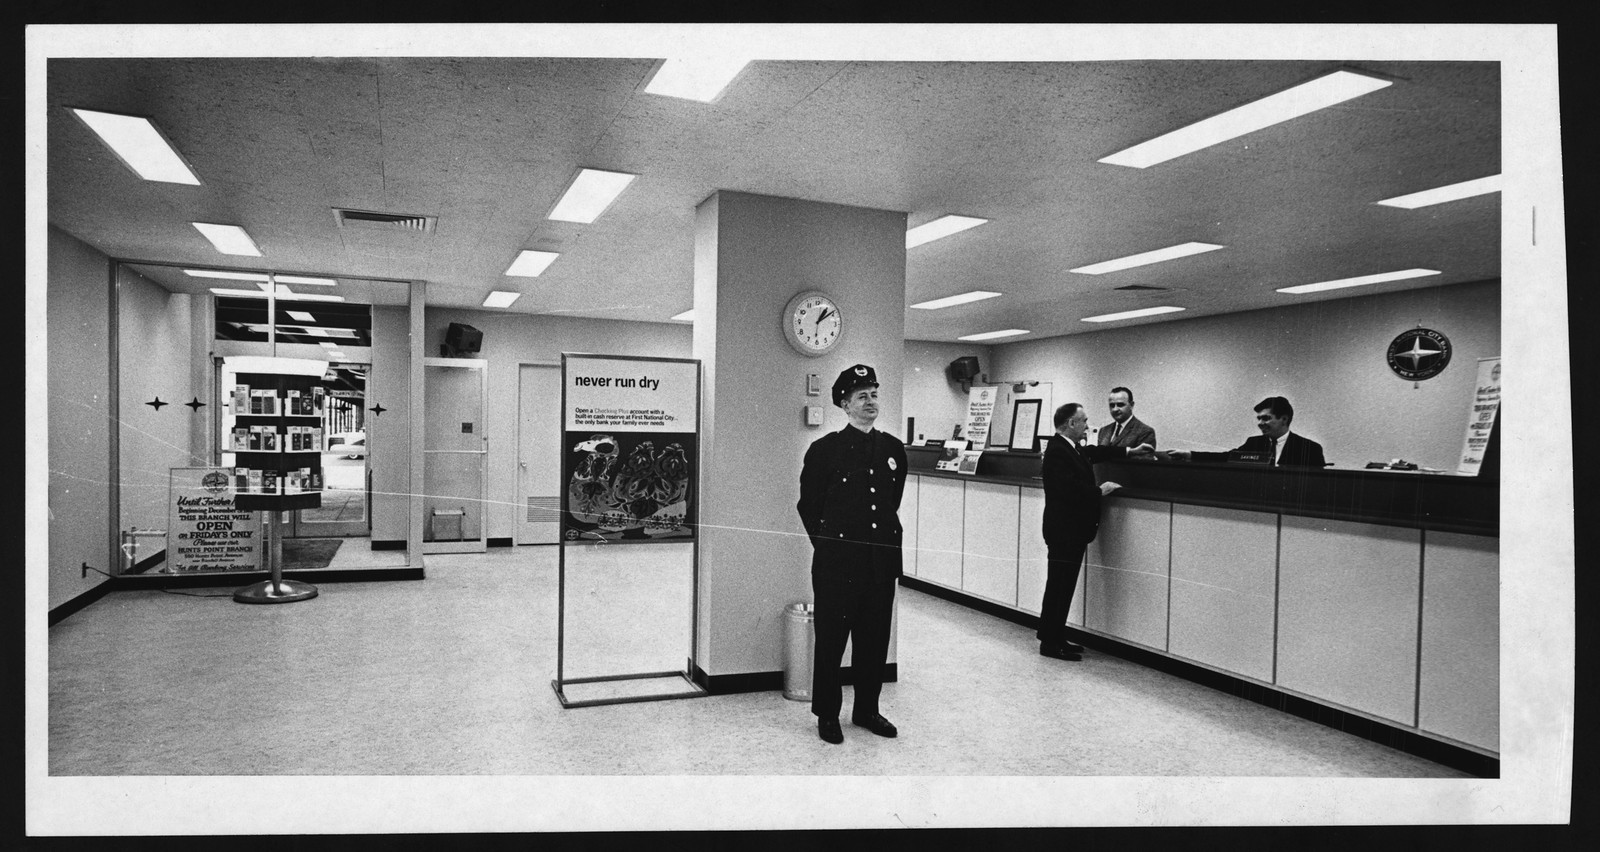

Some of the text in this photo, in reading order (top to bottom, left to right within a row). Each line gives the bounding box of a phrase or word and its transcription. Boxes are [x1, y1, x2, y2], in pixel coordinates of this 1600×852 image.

[1428, 331, 1442, 341] CITY
[575, 375, 660, 391] never run dry
[177, 496, 200, 506] Until
[201, 497, 231, 506] Further
[196, 521, 234, 531] OPEN
[230, 530, 254, 538] ONLY
